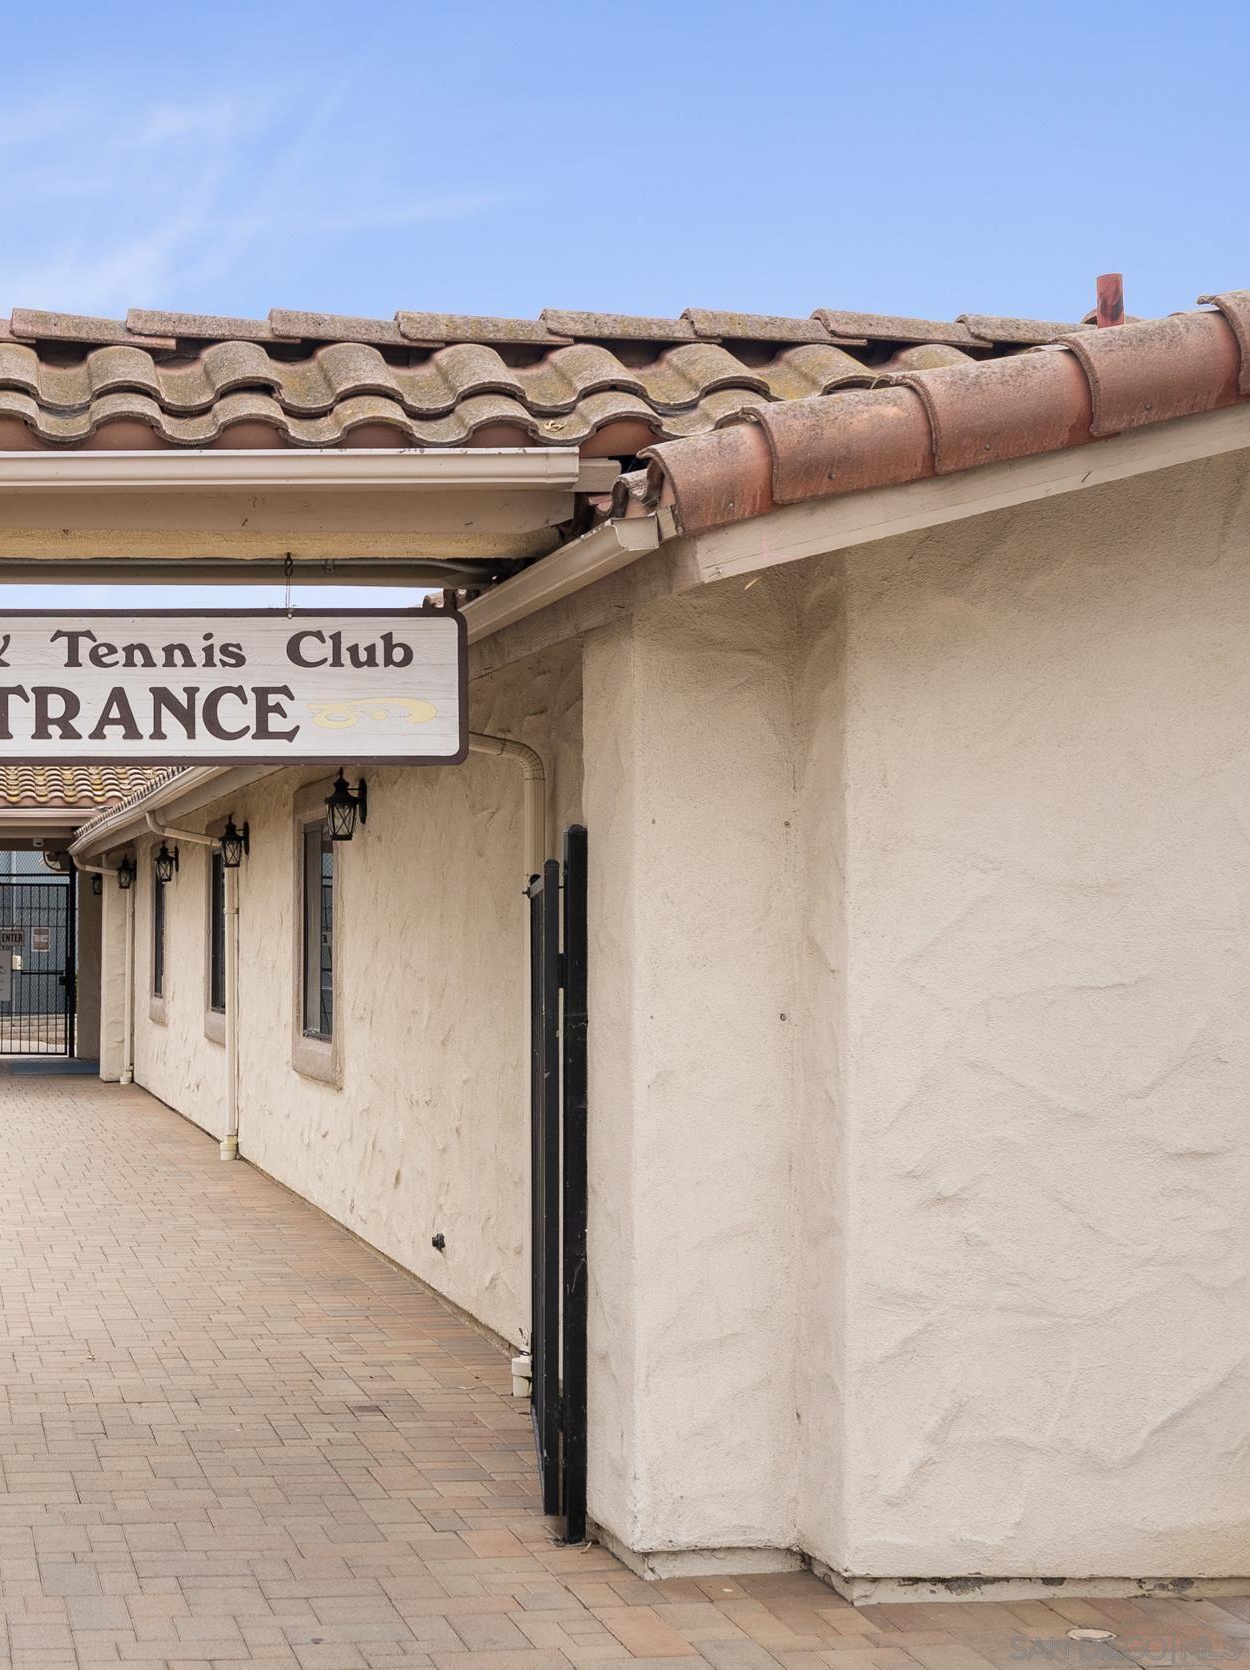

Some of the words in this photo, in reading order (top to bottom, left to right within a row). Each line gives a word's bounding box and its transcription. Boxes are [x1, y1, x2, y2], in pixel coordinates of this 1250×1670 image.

[49, 629, 247, 669] Tennis
[286, 629, 414, 669] Club
[1, 933, 23, 943] ENTER
